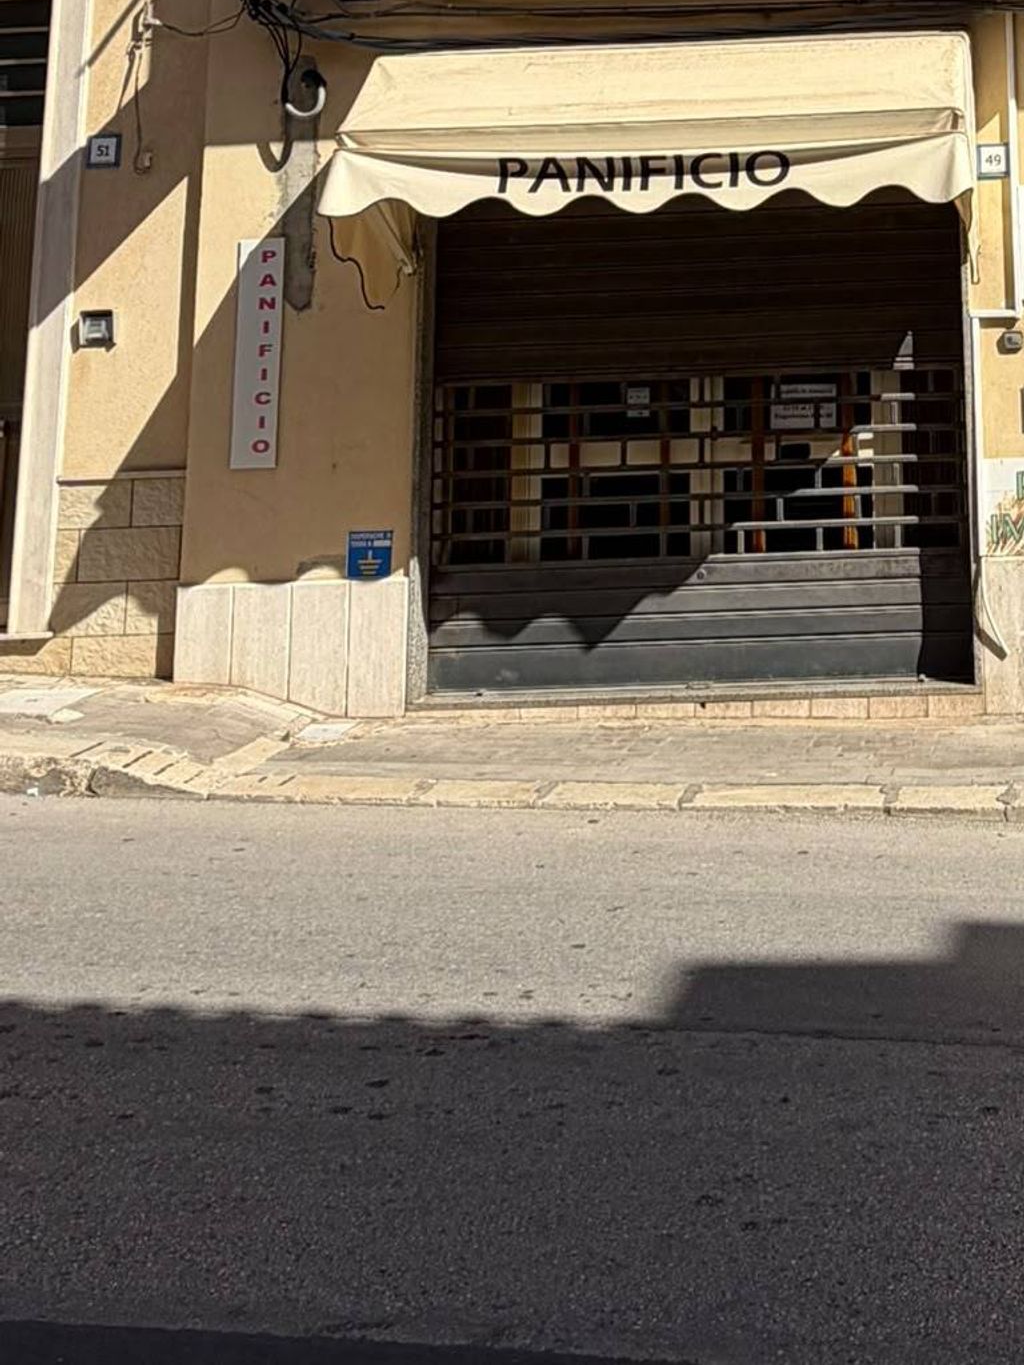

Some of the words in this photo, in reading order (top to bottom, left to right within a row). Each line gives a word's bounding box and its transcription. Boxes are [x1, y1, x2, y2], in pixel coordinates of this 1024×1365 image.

[96, 145, 111, 158] 51
[984, 154, 1001, 167] 49
[496, 150, 791, 194] PANIFICIO
[251, 249, 277, 454] PANIFICIO
